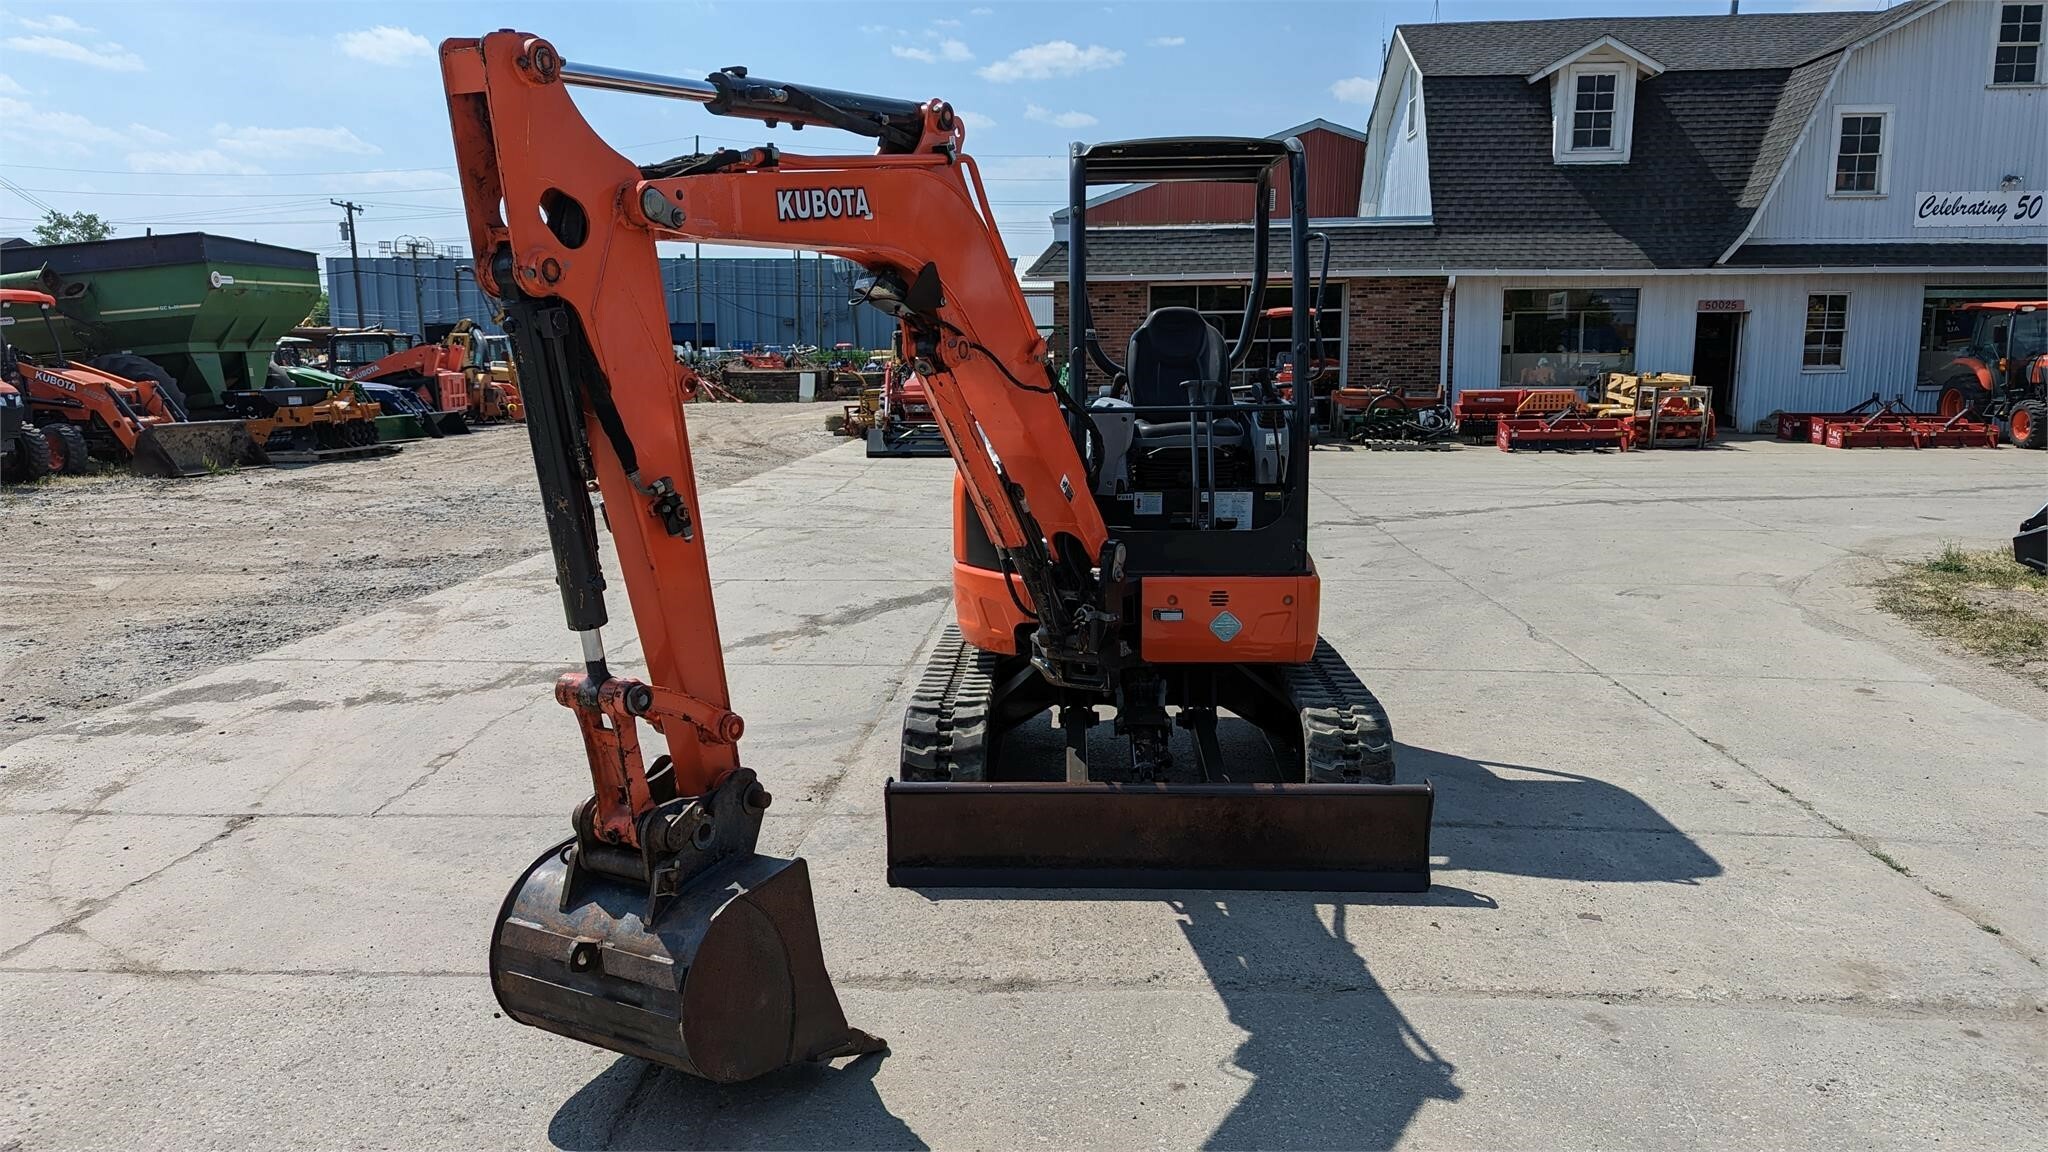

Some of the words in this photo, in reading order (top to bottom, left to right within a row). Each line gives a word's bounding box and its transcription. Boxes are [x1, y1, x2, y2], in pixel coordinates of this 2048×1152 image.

[776, 188, 870, 219] KUBOTA
[1918, 195, 2008, 222] Celebrating
[2013, 195, 2043, 220] 50
[1705, 301, 1737, 310] 50025
[35, 371, 77, 392] KUBOTA
[352, 364, 380, 380] KUBOTA
